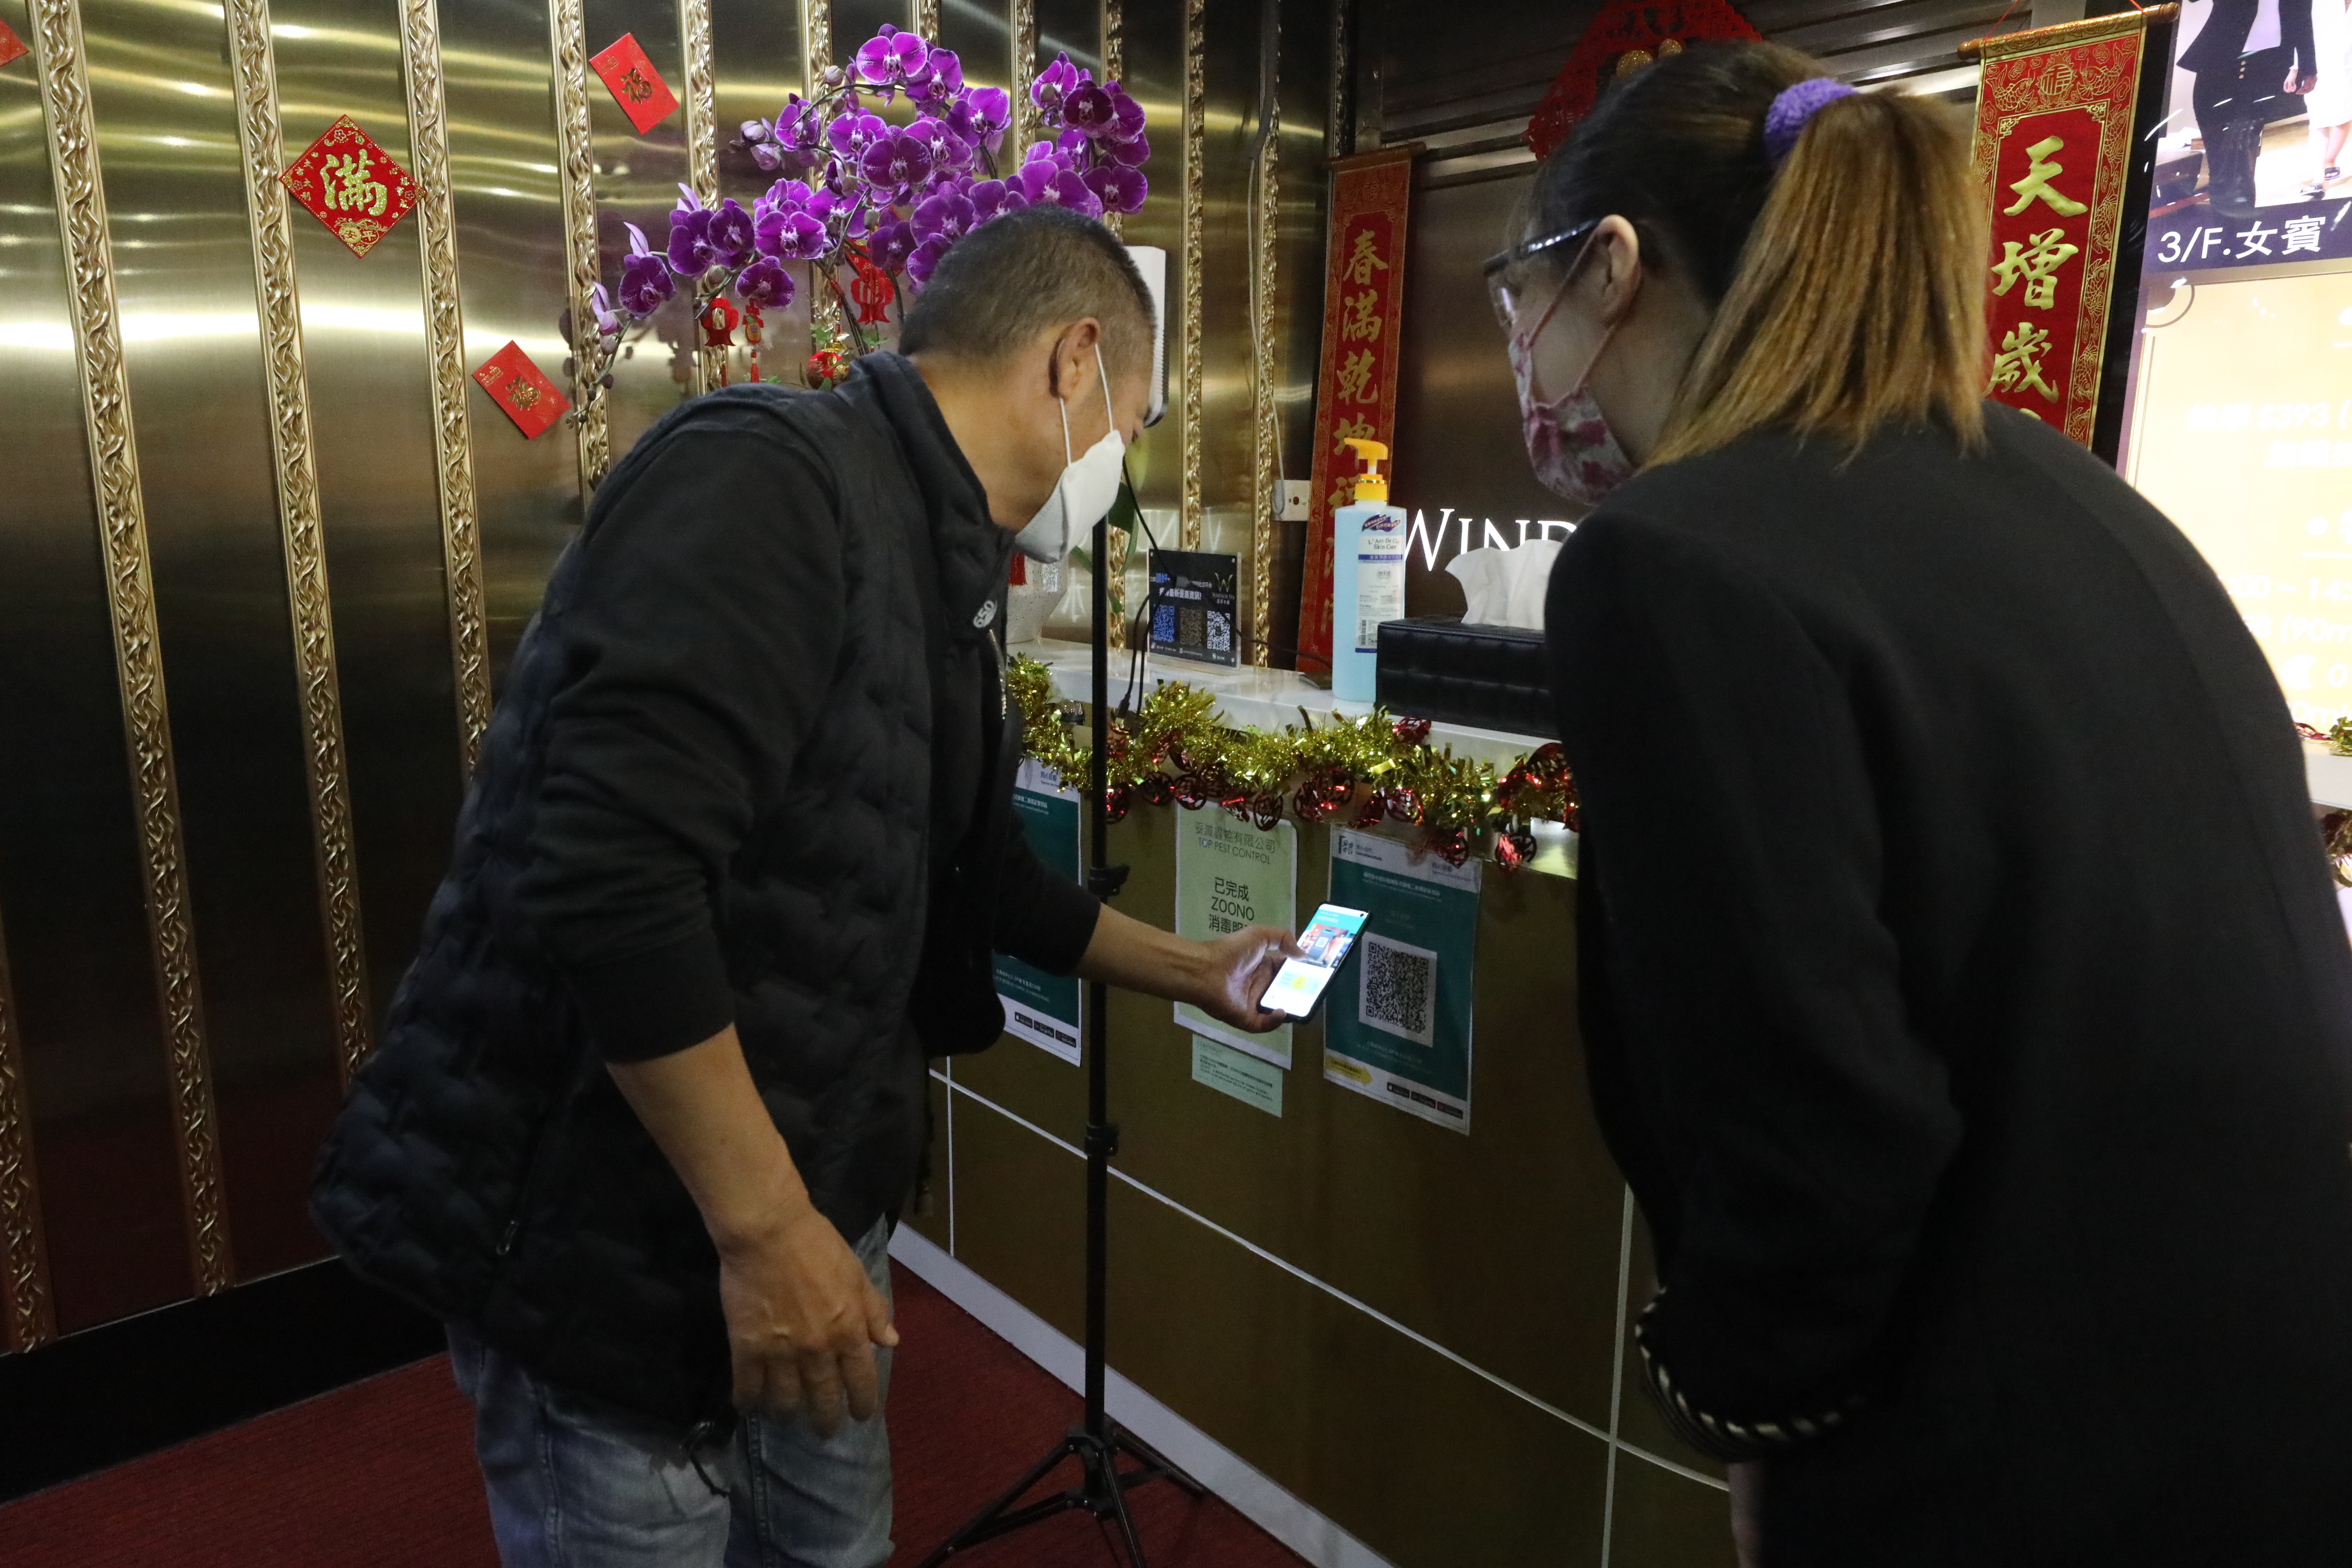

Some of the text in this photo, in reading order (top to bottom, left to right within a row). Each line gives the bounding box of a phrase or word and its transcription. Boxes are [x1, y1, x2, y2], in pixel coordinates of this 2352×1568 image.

[319, 148, 387, 217] 滿
[1983, 135, 2088, 420] 天增歲
[2257, 403, 2329, 429] $393
[2218, 574, 2271, 599] :00
[2309, 577, 2352, 602] 14:
[1198, 837, 1271, 865] TOP PEST CONTROL
[1214, 876, 1249, 901] 已完成
[1211, 896, 1255, 921] ZOONO
[1209, 914, 1248, 933] 消毒服
